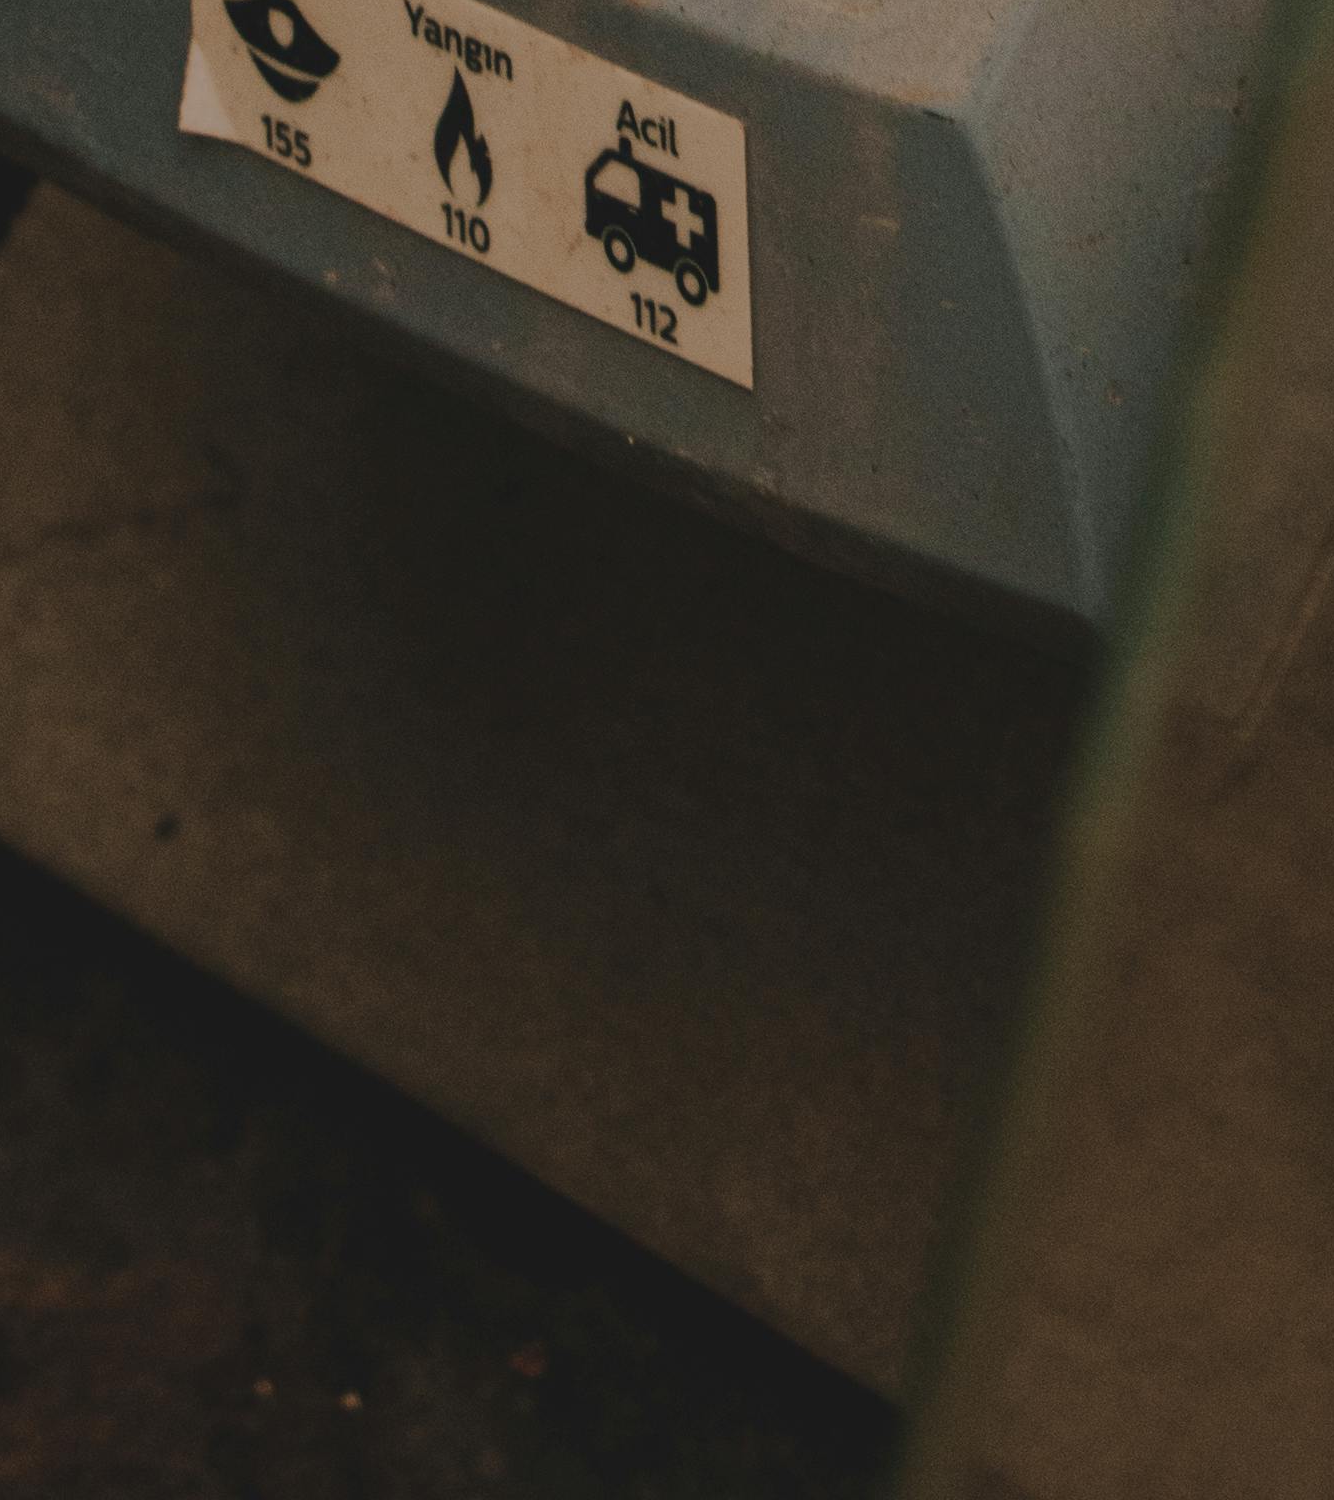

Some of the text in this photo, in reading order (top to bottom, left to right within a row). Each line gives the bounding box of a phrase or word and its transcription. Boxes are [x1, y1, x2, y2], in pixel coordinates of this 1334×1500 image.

[260, 113, 312, 169] 155
[616, 99, 679, 159] Acil
[439, 202, 491, 255] 110
[629, 291, 679, 346] 112
